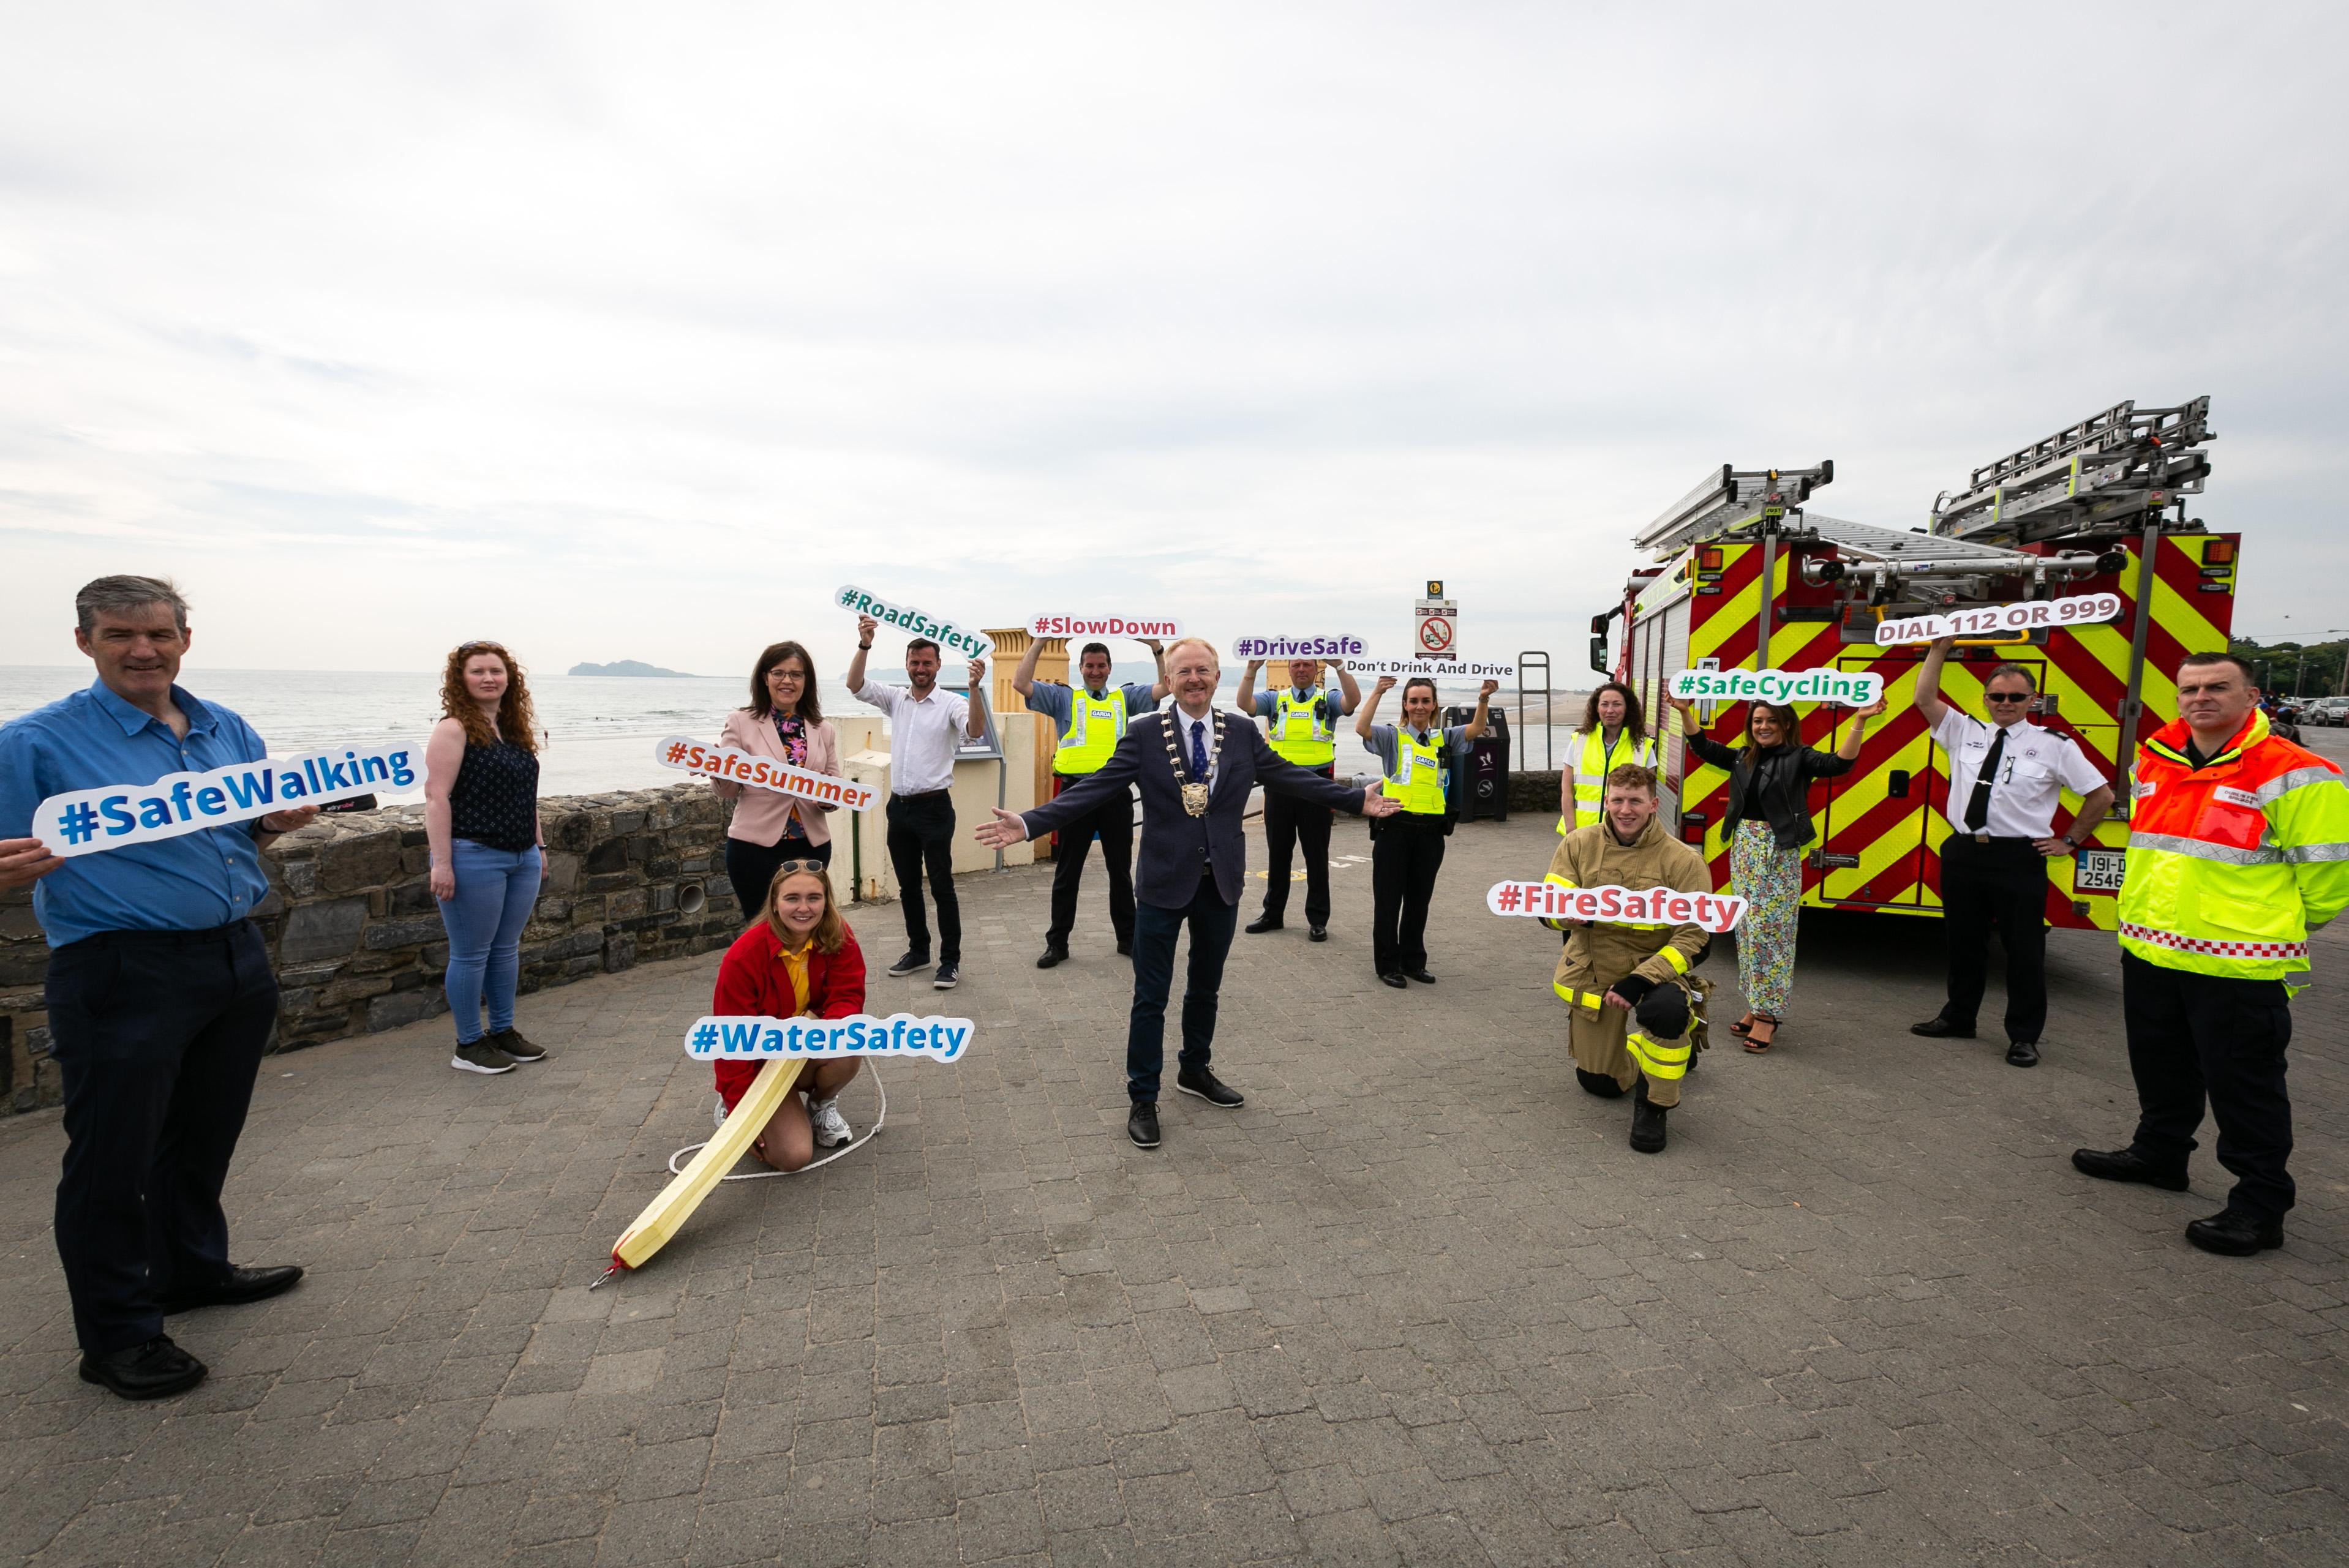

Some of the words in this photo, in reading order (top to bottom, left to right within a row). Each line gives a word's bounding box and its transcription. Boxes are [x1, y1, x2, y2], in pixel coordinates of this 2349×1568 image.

[841, 589, 987, 659] #RoadSafety
[1035, 617, 1176, 635] #SlowDown
[1879, 620, 1939, 641] DIAL
[1950, 612, 1997, 632] 112
[2007, 606, 2050, 626] OR
[2060, 598, 2116, 620] 999
[1238, 637, 1362, 656] #DriveSafe
[1347, 661, 1386, 672] Don't
[1391, 662, 1432, 673] Drink
[1437, 663, 1467, 673] And
[1471, 664, 1513, 675] Drive
[1678, 675, 1871, 702] #SafeCycling
[666, 741, 872, 808] #SafeSummer
[1415, 756, 1434, 767] GARDA
[58, 750, 415, 846] #SafeWalking
[2228, 795, 2253, 805] BRIGADE
[2092, 857, 2126, 872] 191-D
[1498, 885, 1740, 932] #FireSafety
[691, 1021, 966, 1057] #WaterSafety
